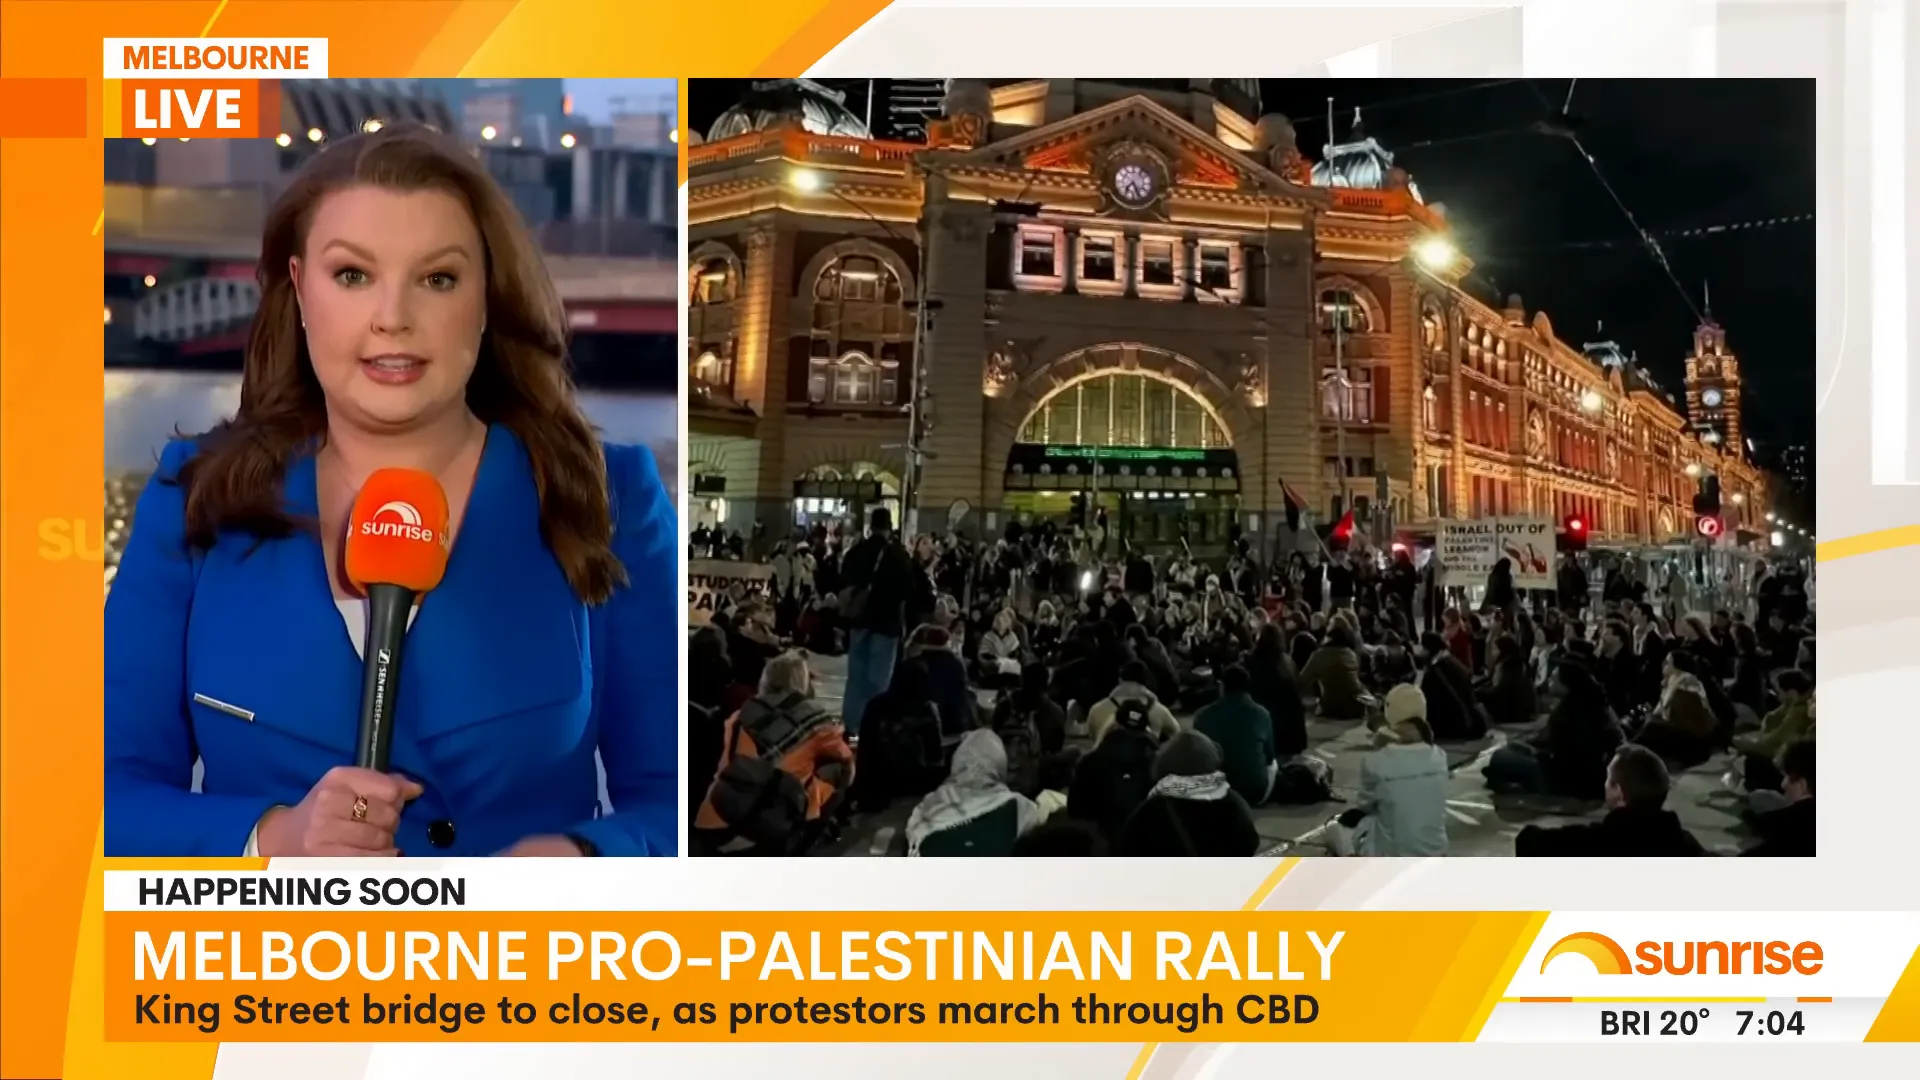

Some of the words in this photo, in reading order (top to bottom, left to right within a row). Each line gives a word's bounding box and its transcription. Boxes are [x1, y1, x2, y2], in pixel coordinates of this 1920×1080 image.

[361, 521, 433, 543] sunrise
[1444, 524, 1492, 535] ISRAEL
[1496, 523, 1524, 534] OUT
[1528, 523, 1547, 535] OF
